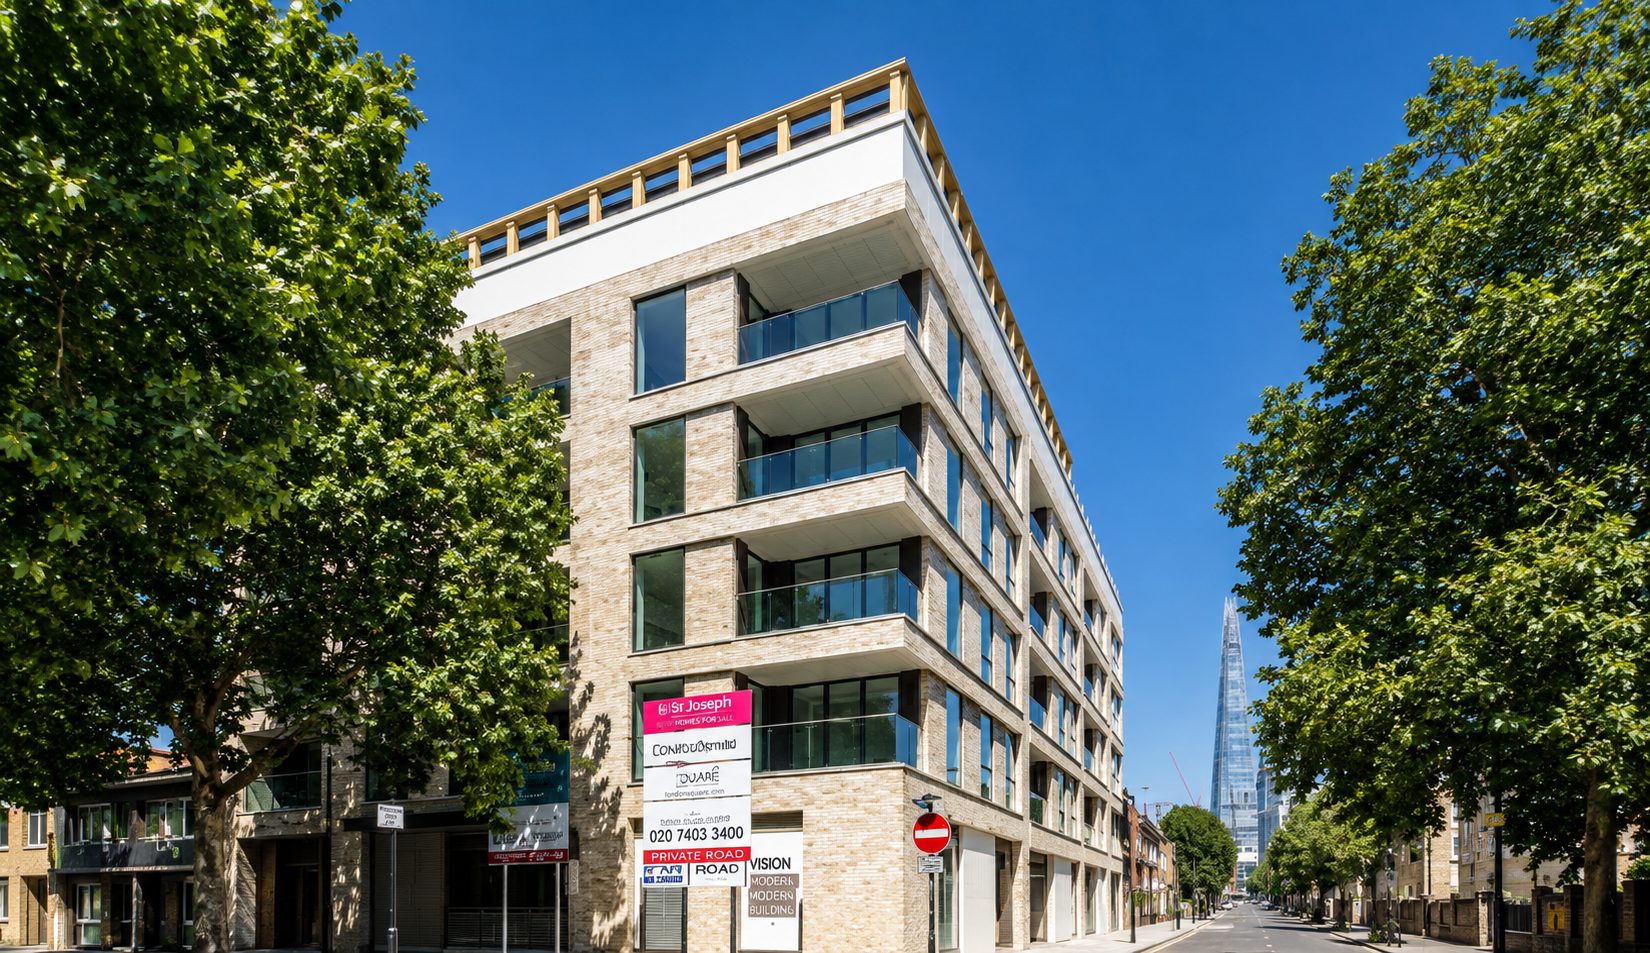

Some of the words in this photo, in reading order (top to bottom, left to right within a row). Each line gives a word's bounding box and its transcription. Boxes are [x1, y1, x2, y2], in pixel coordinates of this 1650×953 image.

[685, 695, 732, 713] Joseph
[649, 829, 673, 843] 020
[676, 827, 707, 842] 7403
[711, 826, 744, 841] 3400
[651, 851, 701, 862] PRIVATE
[705, 849, 744, 860] ROAD
[695, 863, 739, 875] ROAD
[750, 857, 791, 871] VISION
[750, 890, 794, 901] MODERN
[750, 905, 794, 916] BUILDING
